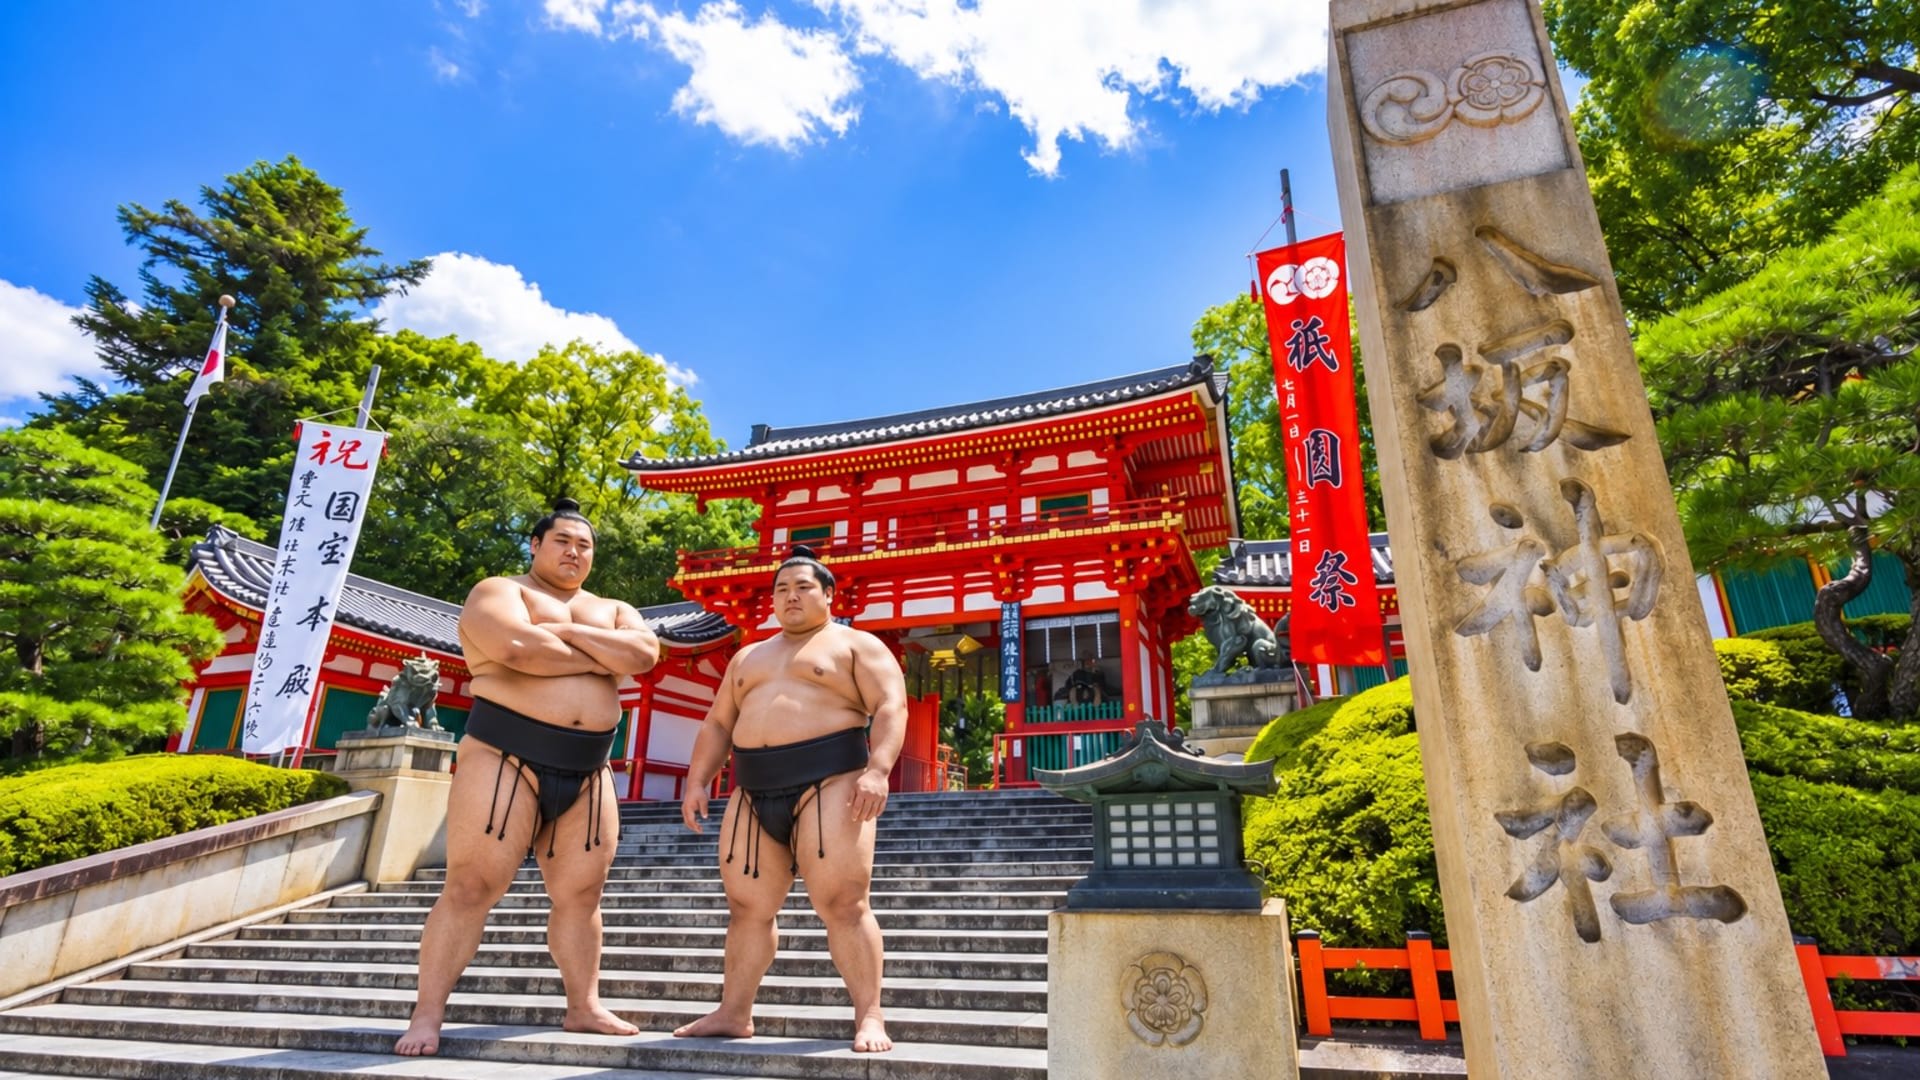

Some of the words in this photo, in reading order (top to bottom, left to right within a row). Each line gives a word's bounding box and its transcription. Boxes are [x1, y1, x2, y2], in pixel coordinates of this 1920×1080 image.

[309, 430, 369, 471] 祝
[1398, 224, 1748, 944] 八坂神社
